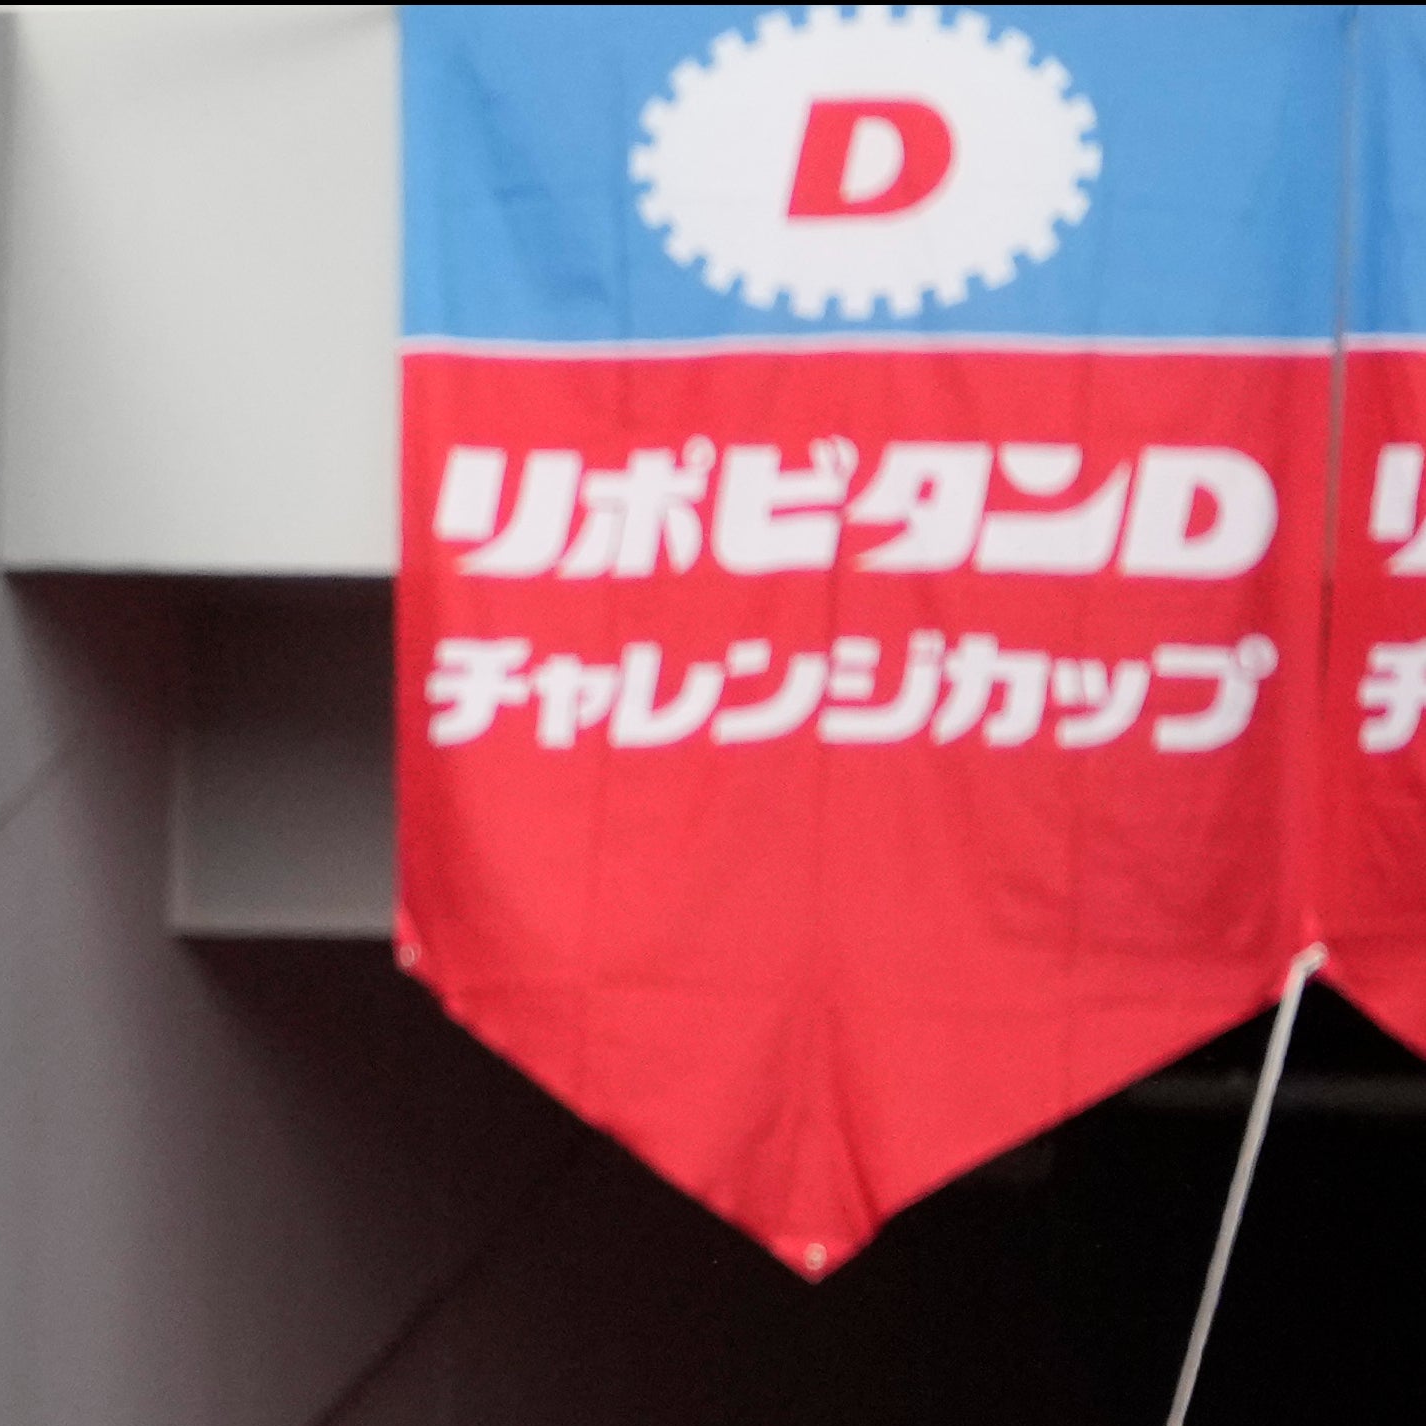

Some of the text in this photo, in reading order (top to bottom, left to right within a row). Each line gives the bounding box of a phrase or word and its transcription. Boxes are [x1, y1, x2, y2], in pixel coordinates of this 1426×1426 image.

[788, 98, 958, 223] D
[433, 437, 1278, 579] リポビタンD
[427, 631, 1278, 753] チャレンジカップ
